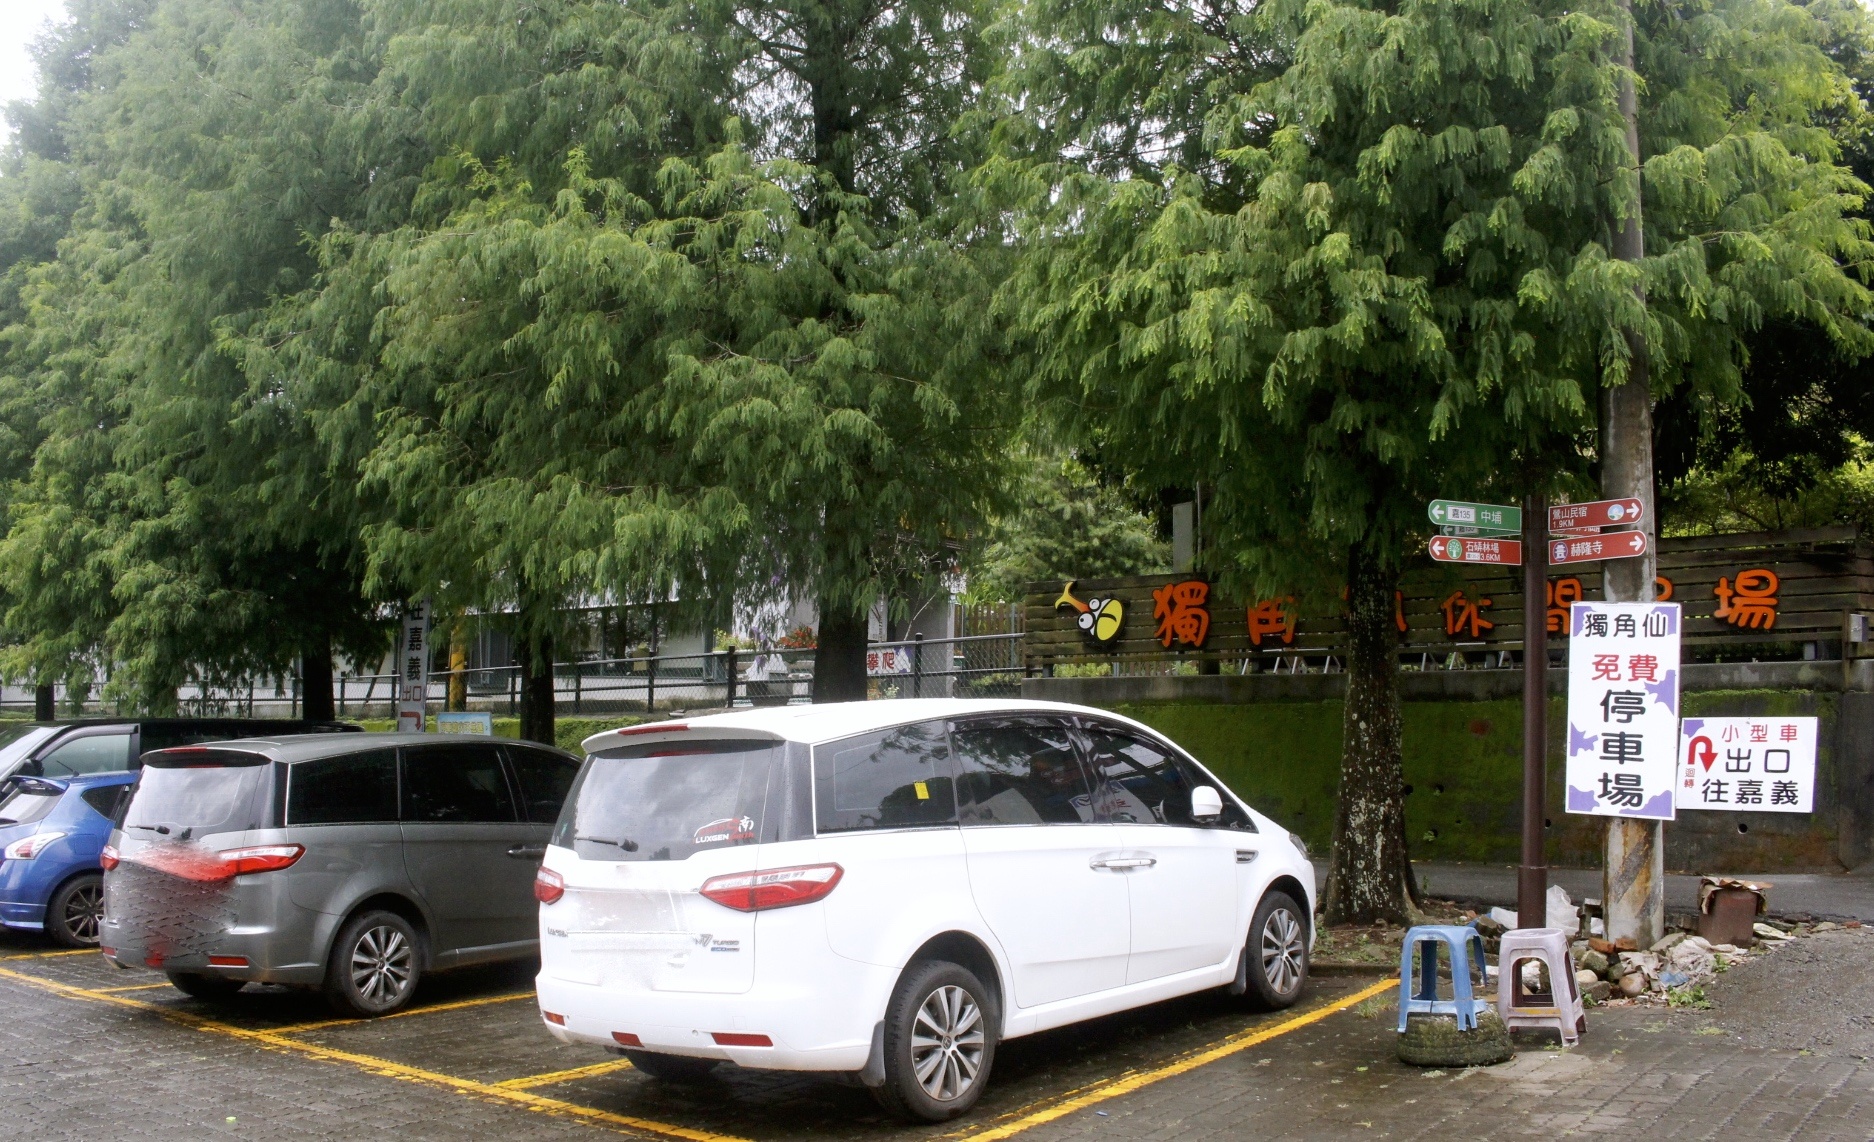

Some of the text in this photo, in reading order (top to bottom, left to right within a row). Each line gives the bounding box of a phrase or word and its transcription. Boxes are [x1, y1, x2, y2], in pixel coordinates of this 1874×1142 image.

[1480, 509, 1502, 525] 中埔
[1553, 519, 1574, 528] 1.9KM
[1480, 553, 1501, 562] 3.6KM
[1585, 613, 1668, 639] 獨角仙
[1591, 653, 1659, 683] 免費
[402, 686, 422, 702] 出口
[1721, 723, 1799, 744] 小型車
[1597, 689, 1647, 808] 停車場
[1725, 747, 1791, 775] 出口
[1701, 778, 1799, 806] 往嘉義
[695, 833, 730, 844] LUXGEN
